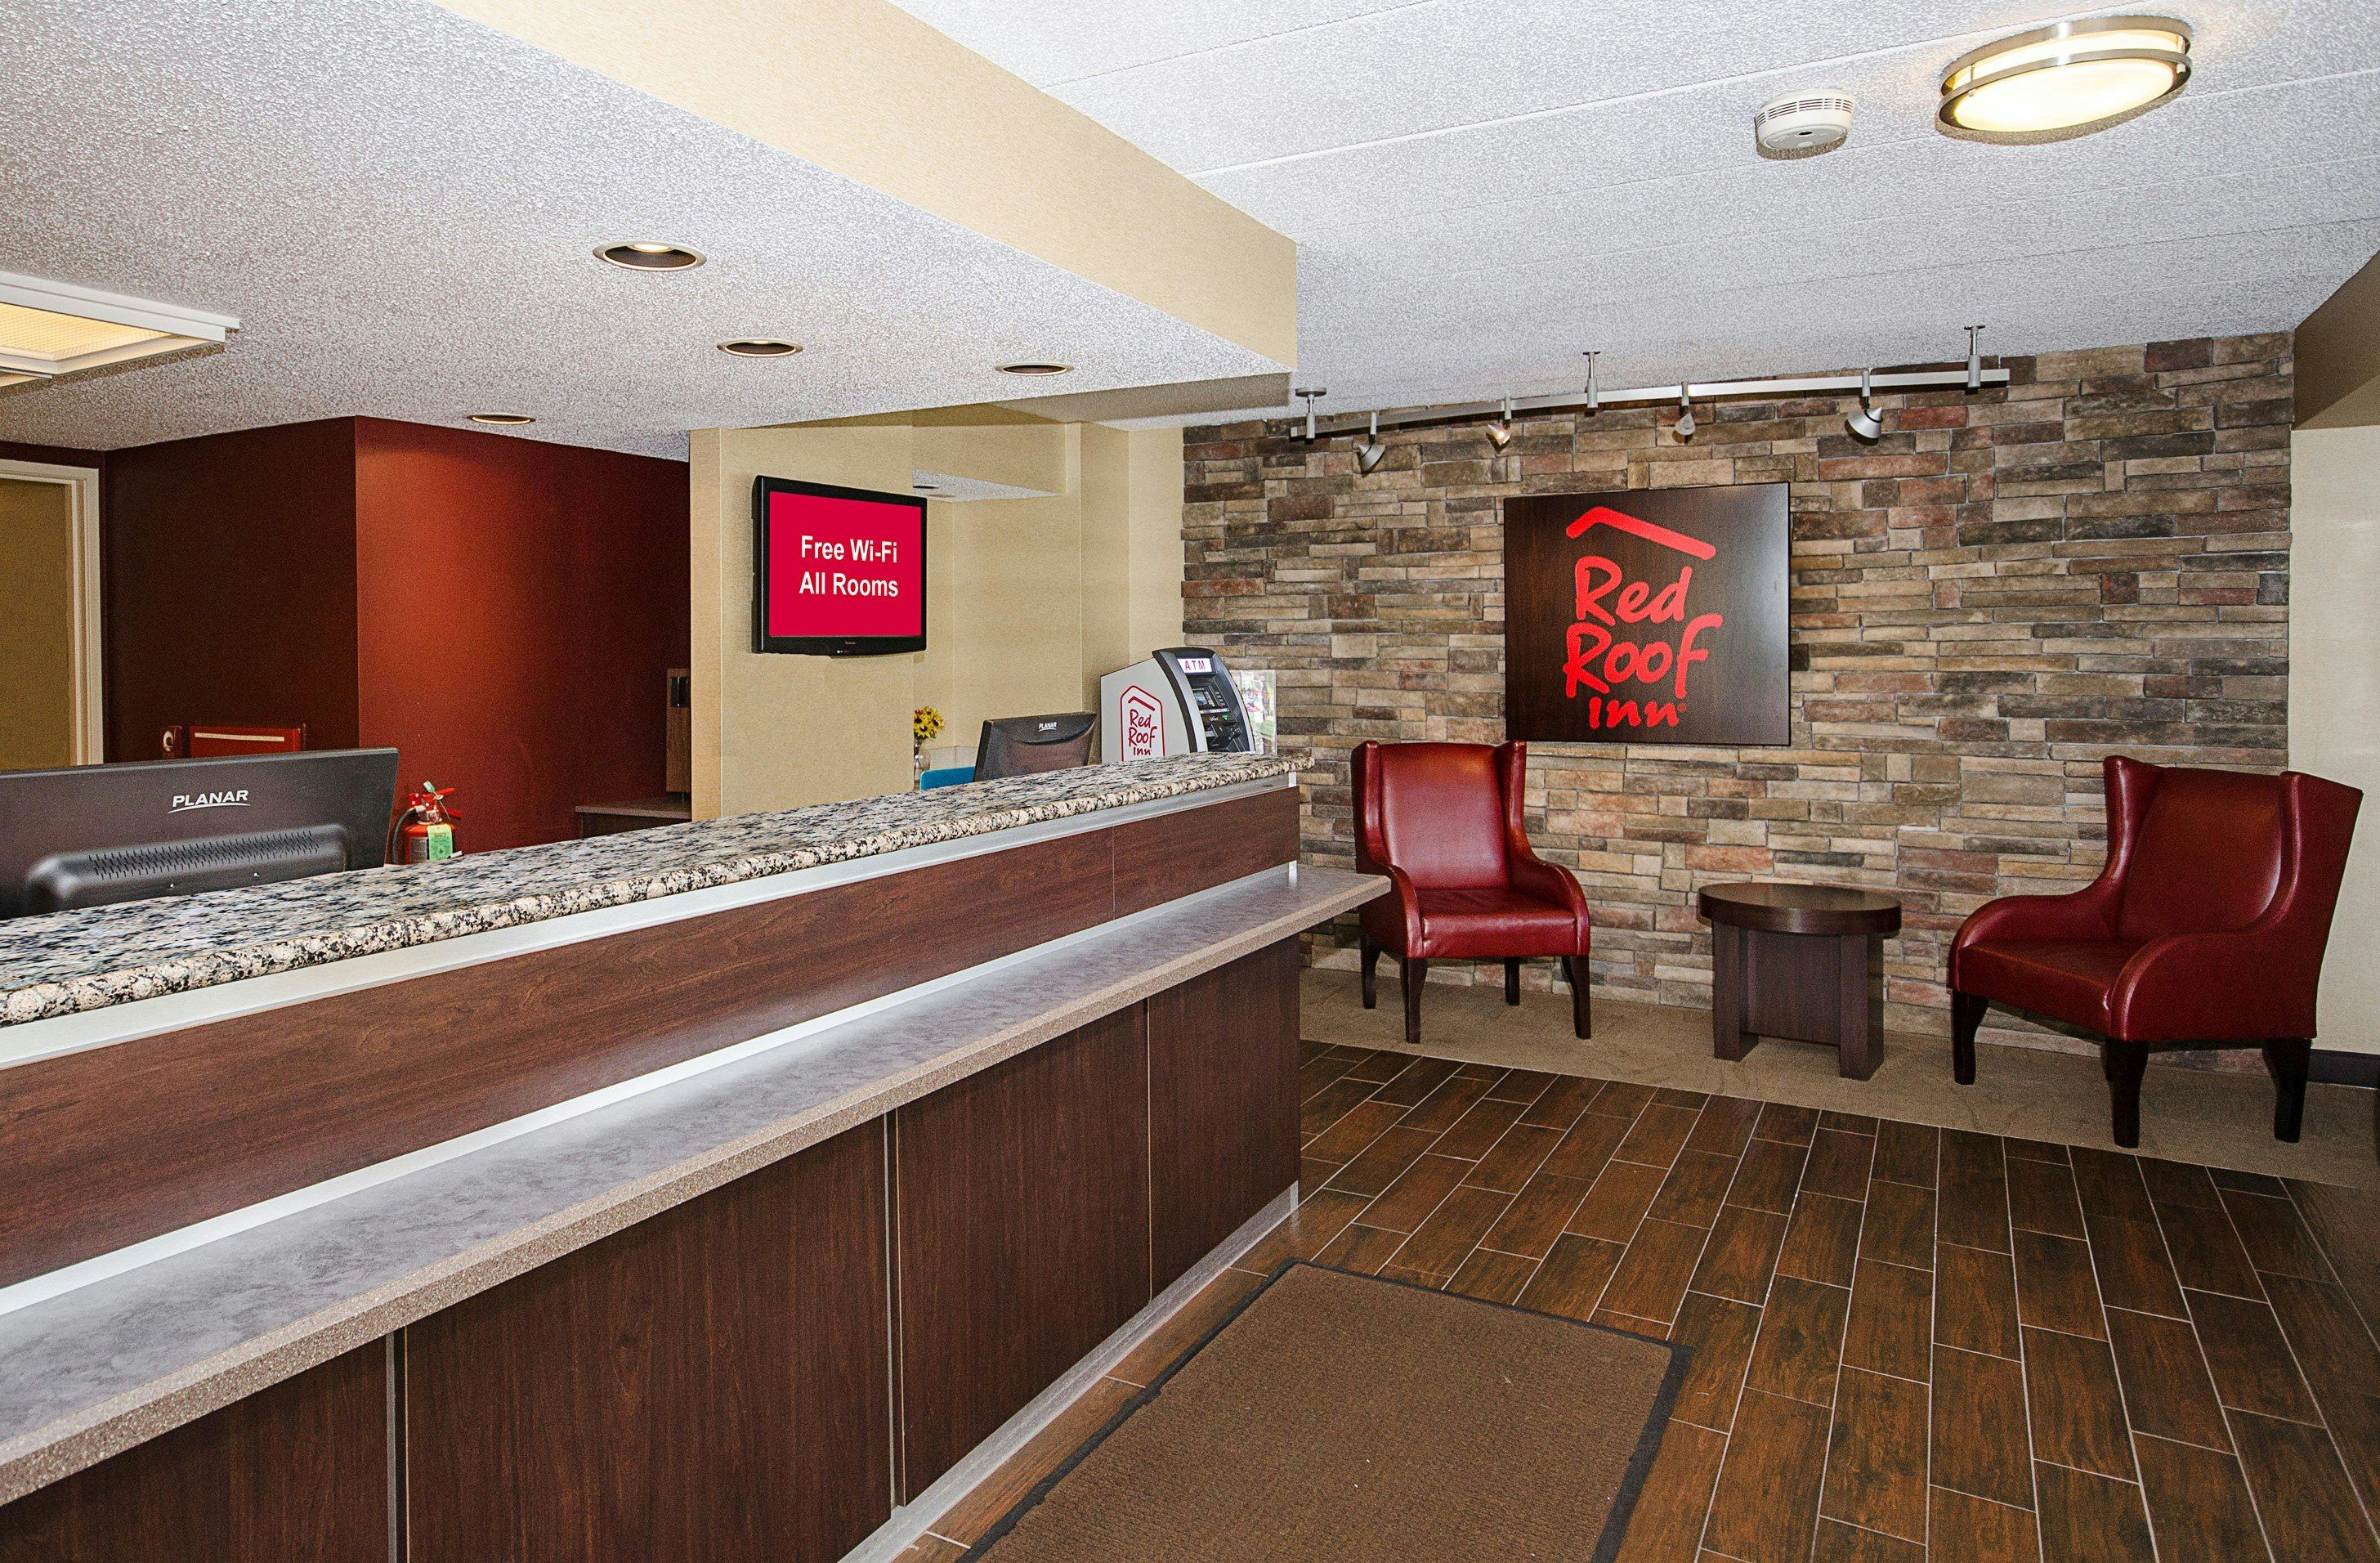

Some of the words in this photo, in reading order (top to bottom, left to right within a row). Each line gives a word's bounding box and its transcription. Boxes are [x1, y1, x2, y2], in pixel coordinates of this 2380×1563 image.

[800, 535, 845, 561] Free
[849, 538, 898, 563] Wi-Fi
[799, 571, 826, 595] All
[832, 572, 899, 598] Rooms
[1574, 555, 1693, 627] Red
[1184, 659, 1206, 671] ATM
[1563, 613, 1724, 700] Roof
[1038, 721, 1058, 729] PLANAR
[1130, 708, 1152, 728] Red
[1128, 725, 1158, 749] Roof
[172, 789, 249, 808] PLANAR
